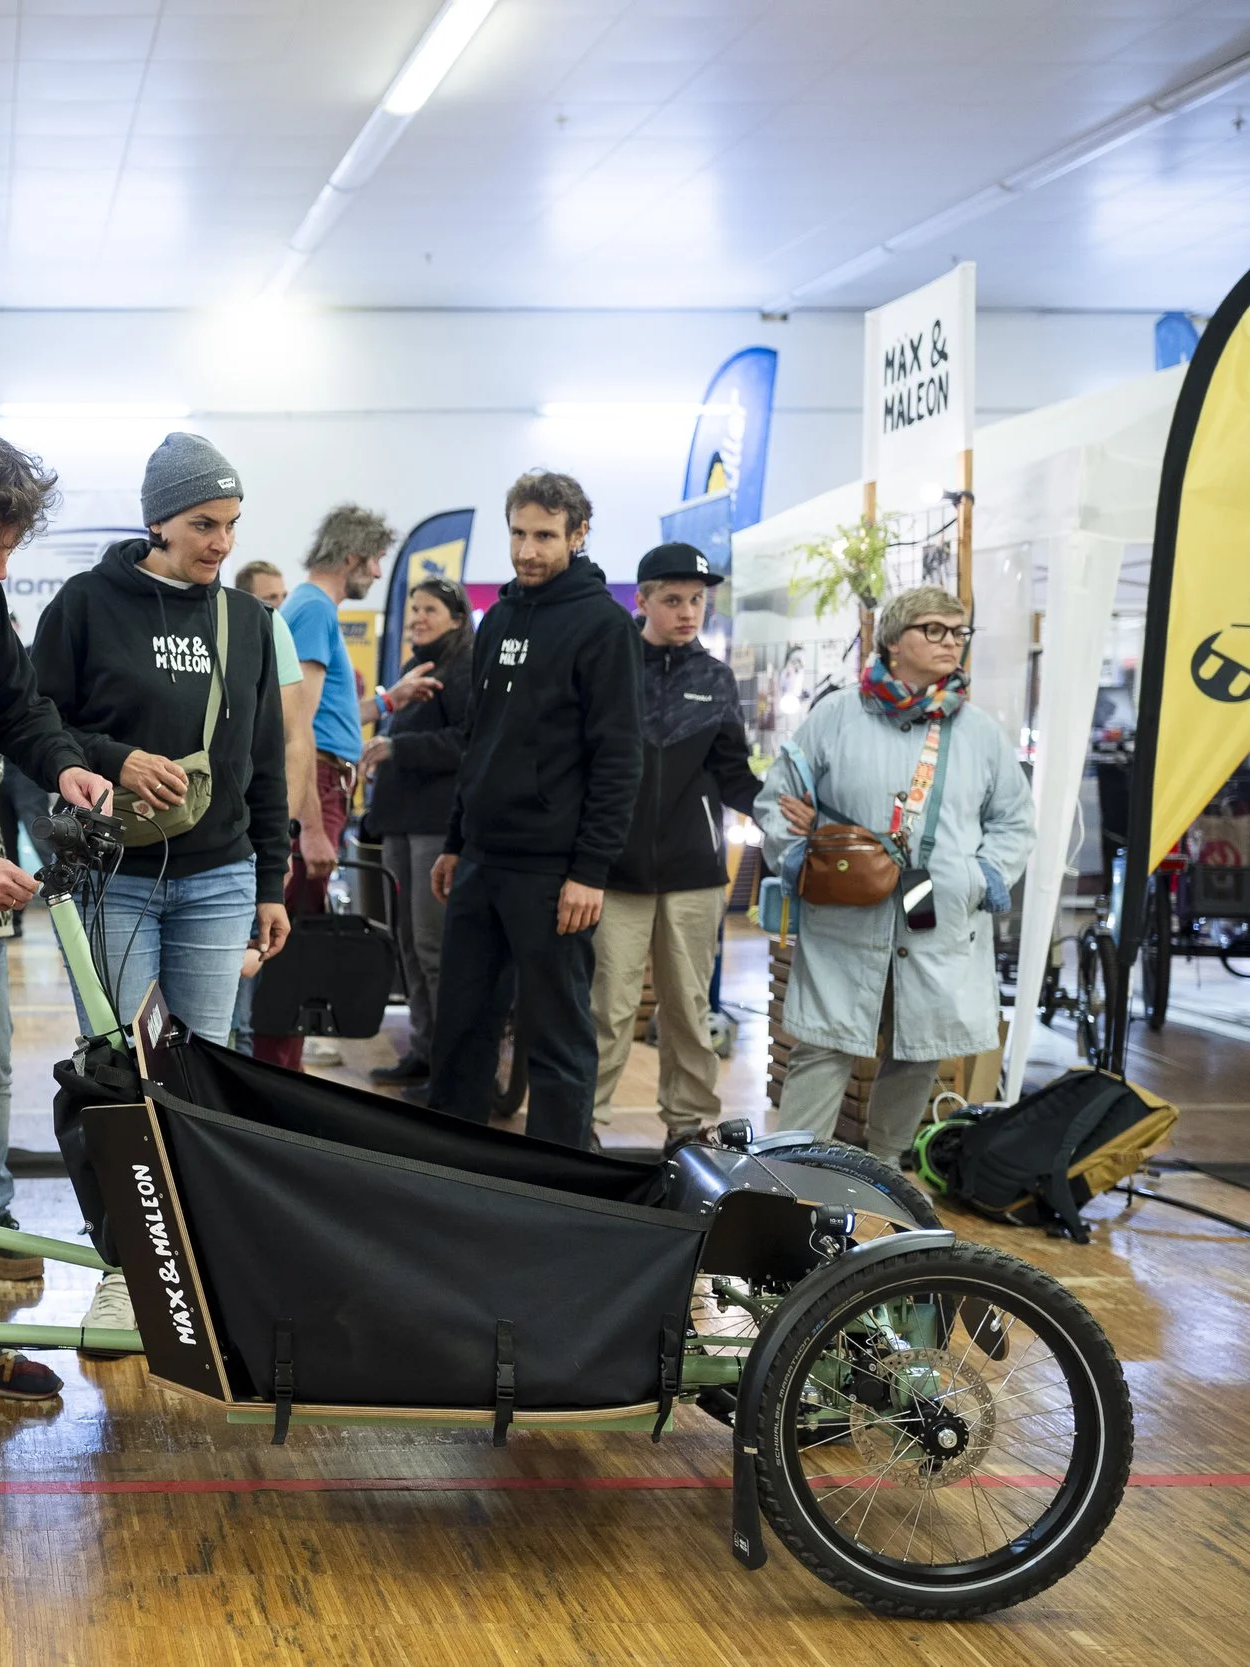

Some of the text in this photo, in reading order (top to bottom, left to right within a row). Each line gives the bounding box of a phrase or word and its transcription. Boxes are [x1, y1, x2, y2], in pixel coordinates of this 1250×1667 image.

[931, 319, 948, 368] &
[192, 636, 209, 656] &
[158, 1258, 180, 1284] &
[779, 1336, 811, 1399] MARATHON
